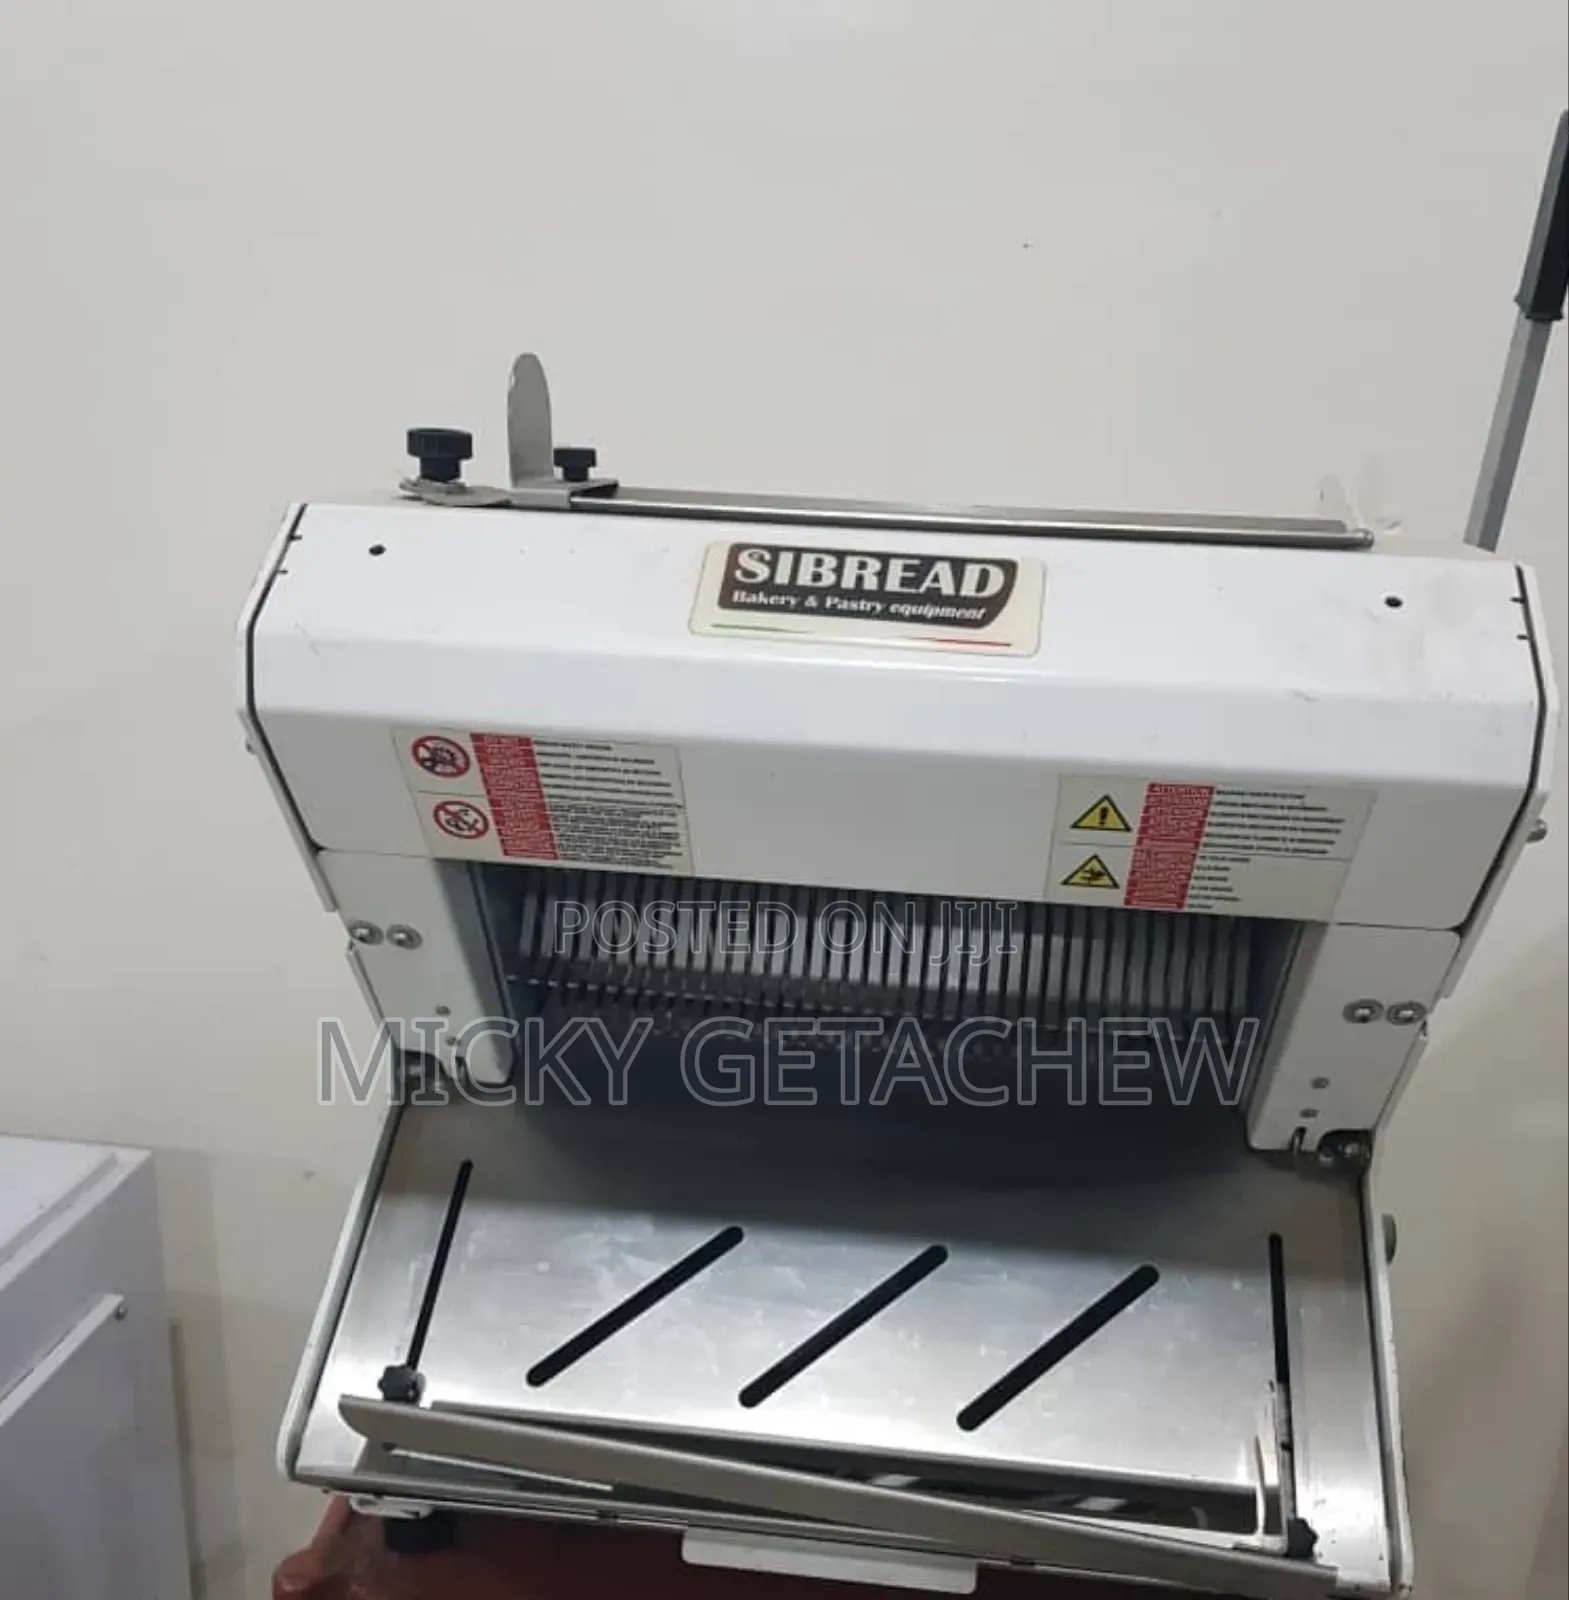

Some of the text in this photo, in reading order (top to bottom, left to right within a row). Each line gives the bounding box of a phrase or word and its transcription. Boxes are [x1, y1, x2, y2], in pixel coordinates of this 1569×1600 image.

[734, 549, 1004, 597] SIBREAD
[733, 589, 986, 621] Bakery & Pastry equipment
